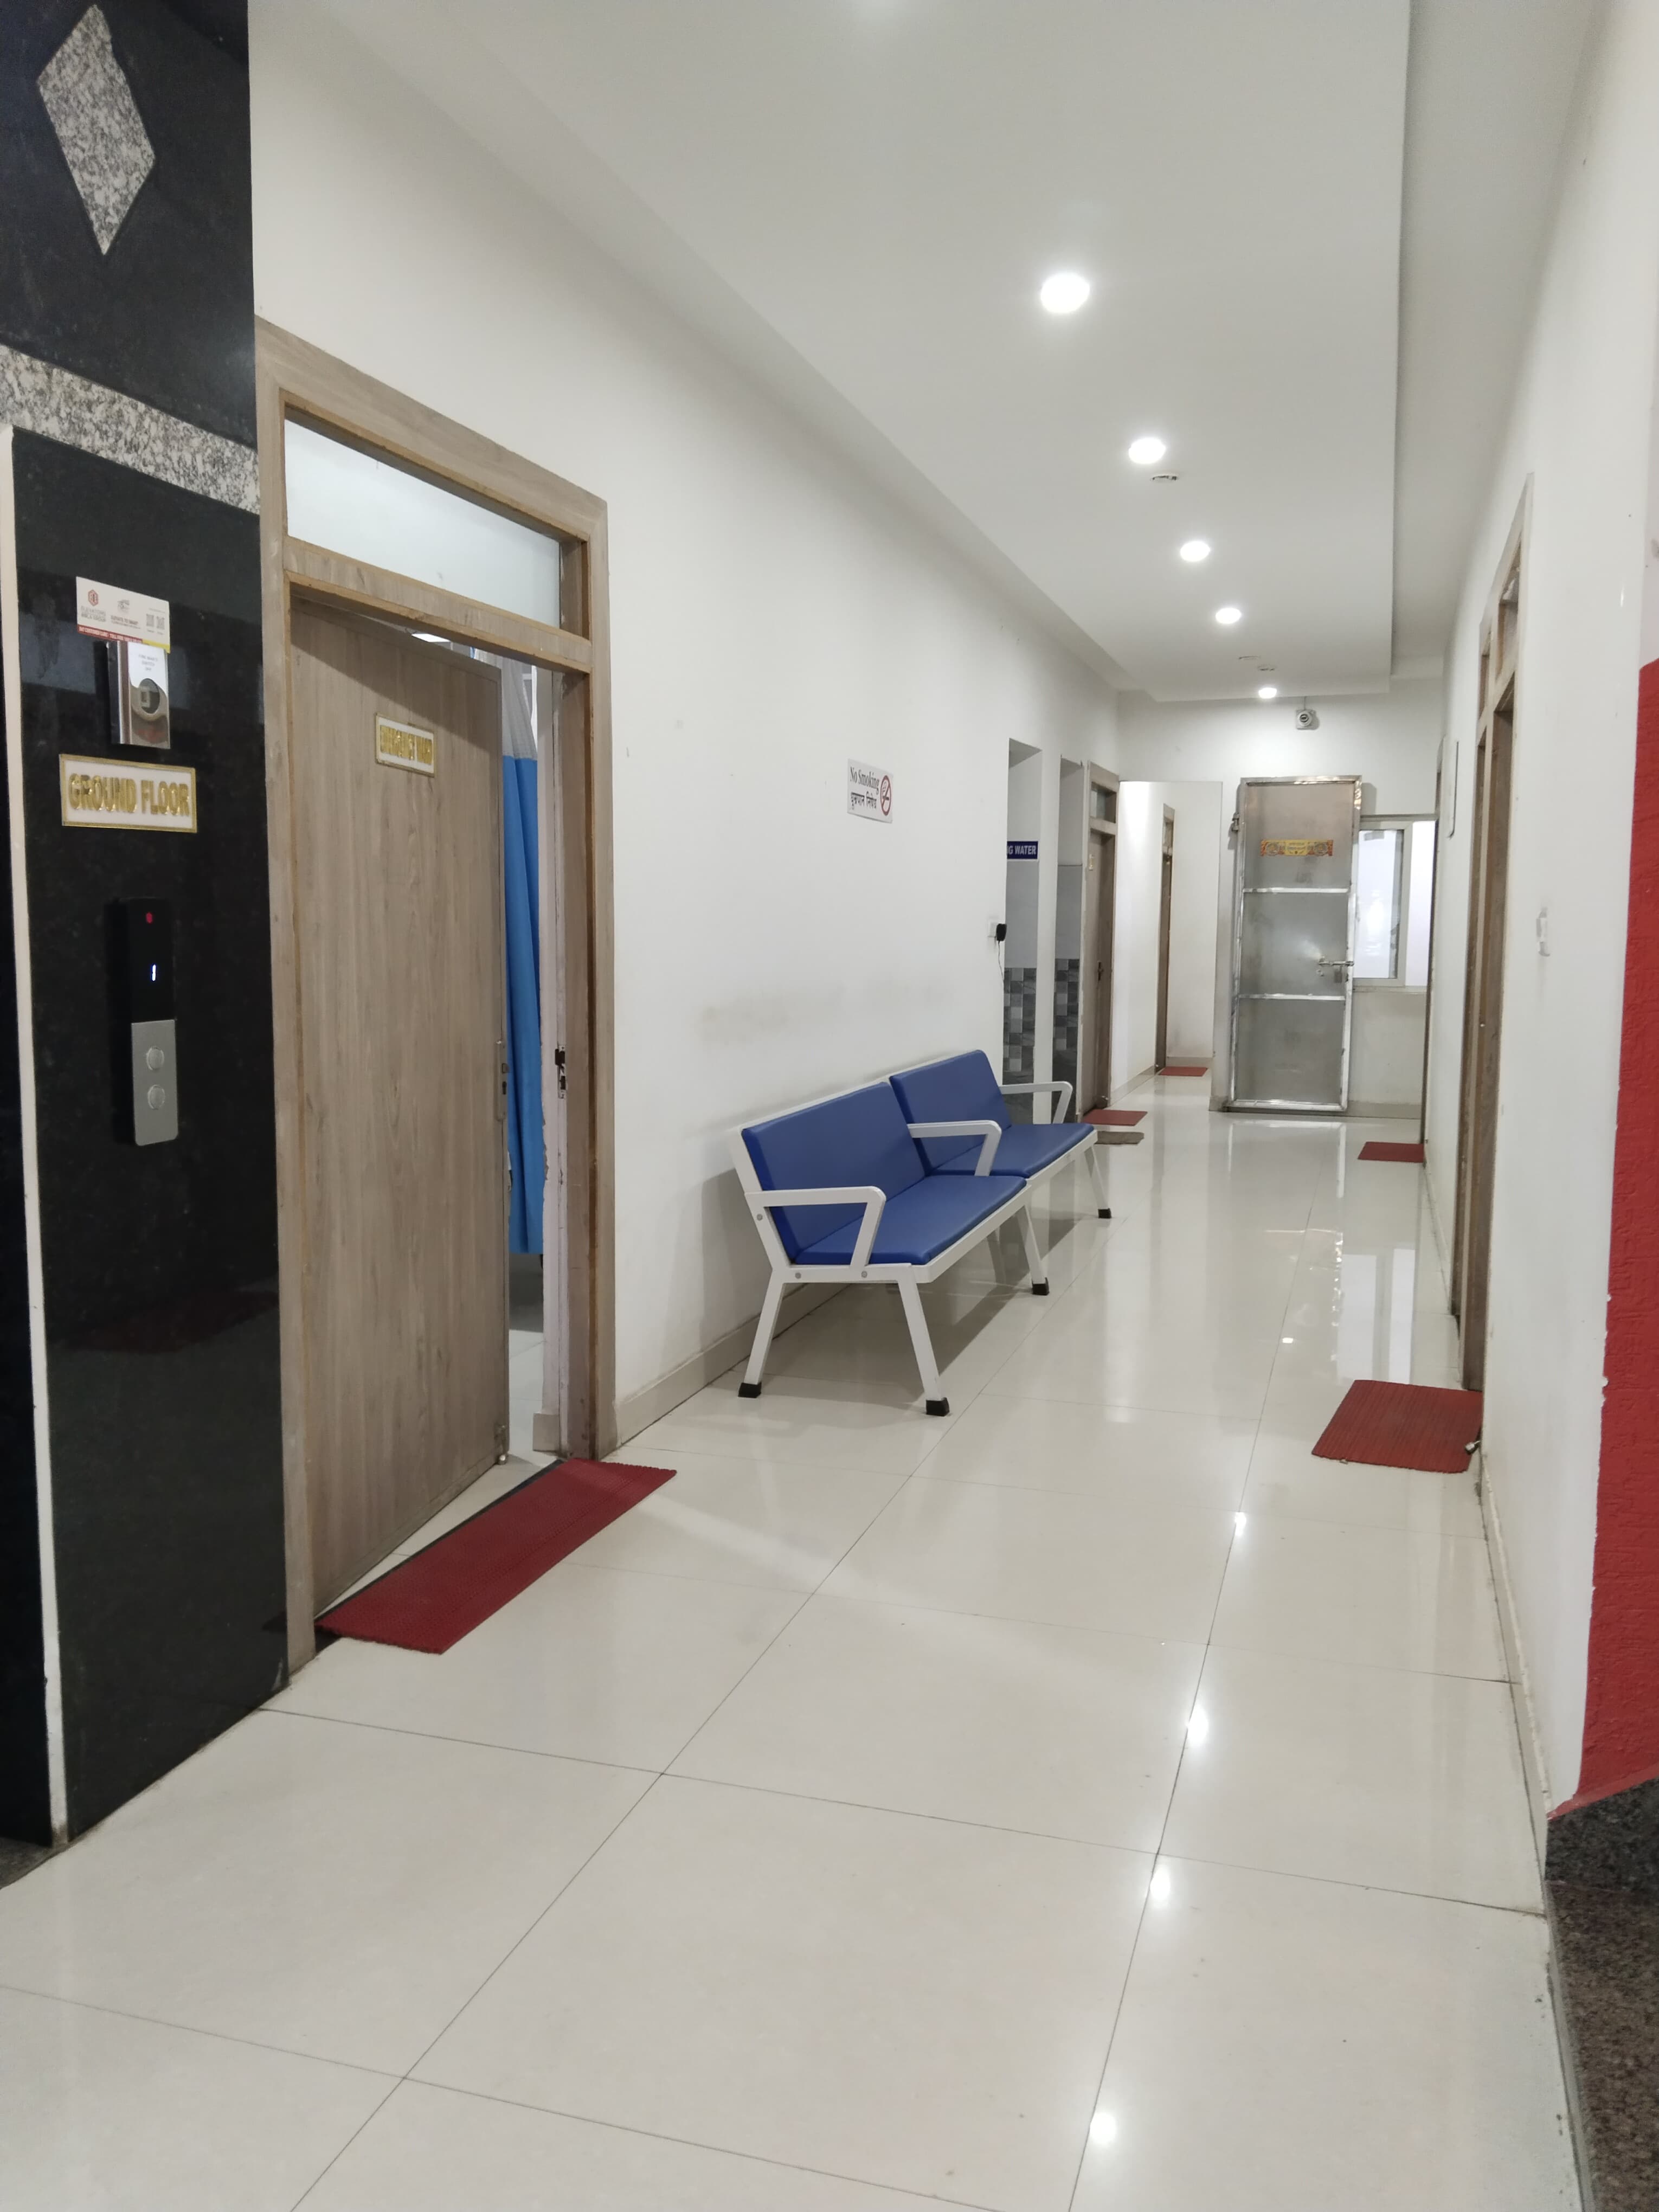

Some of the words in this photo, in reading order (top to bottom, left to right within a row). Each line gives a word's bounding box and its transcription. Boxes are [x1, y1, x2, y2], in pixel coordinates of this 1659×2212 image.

[69, 773, 137, 813] GROUND
[140, 780, 190, 817] FLOOR
[850, 767, 857, 783] No
[858, 769, 879, 795] Smoking
[1015, 845, 1037, 854] WATER
